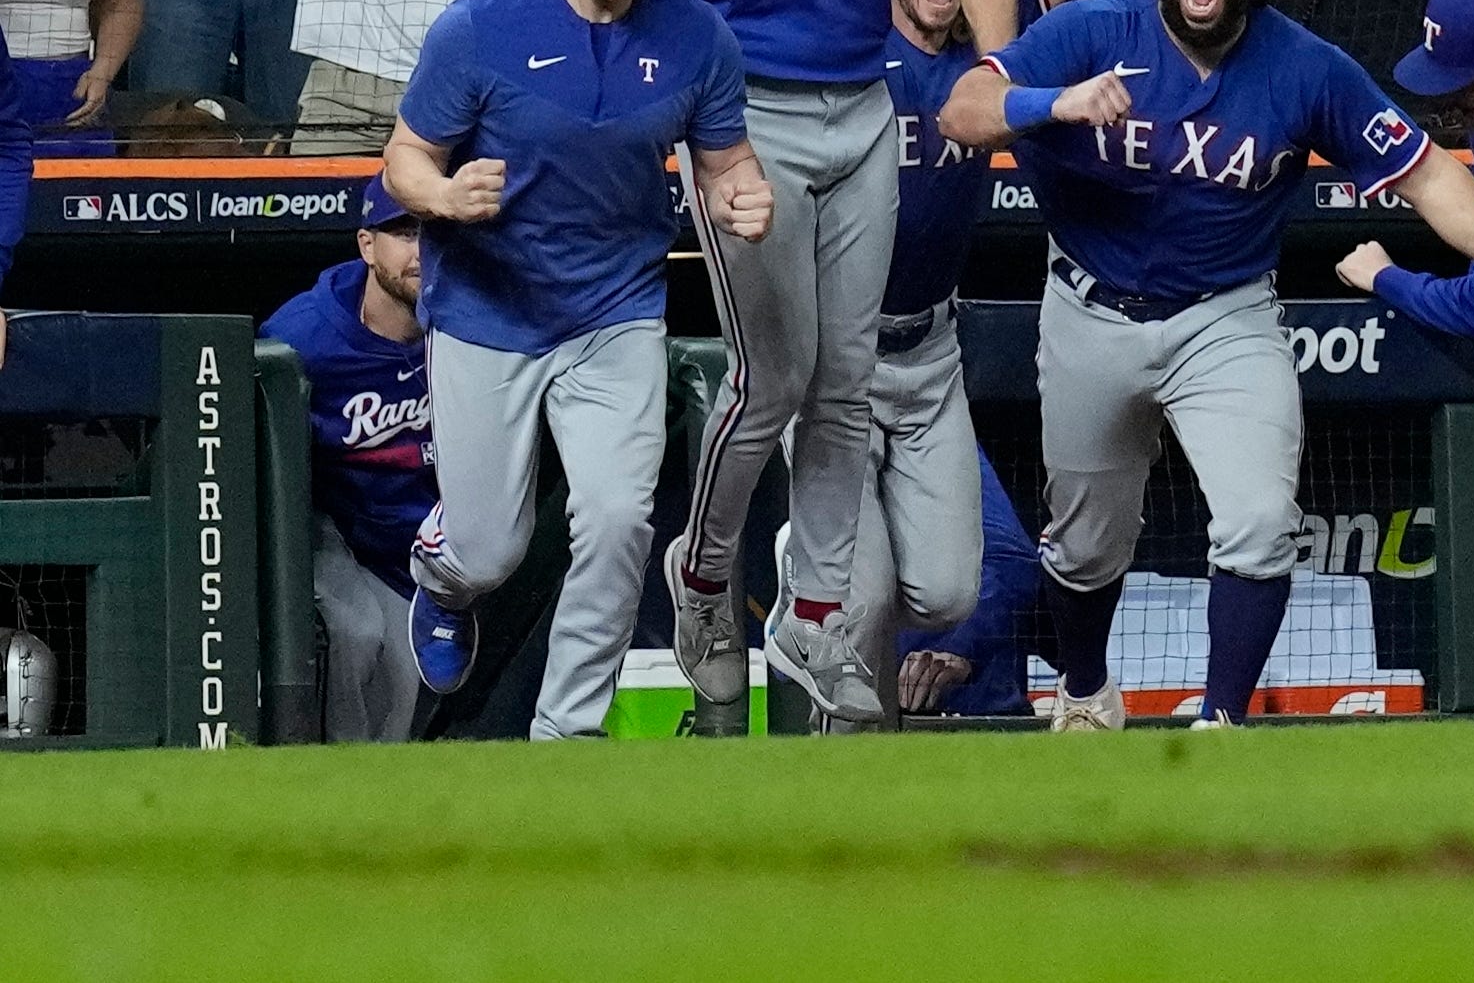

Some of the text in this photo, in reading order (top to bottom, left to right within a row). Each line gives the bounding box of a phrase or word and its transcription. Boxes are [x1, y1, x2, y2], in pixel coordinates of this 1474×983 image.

[1423, 16, 1442, 52] T
[639, 57, 660, 84] T
[106, 190, 349, 222] ALCS loanDepot
